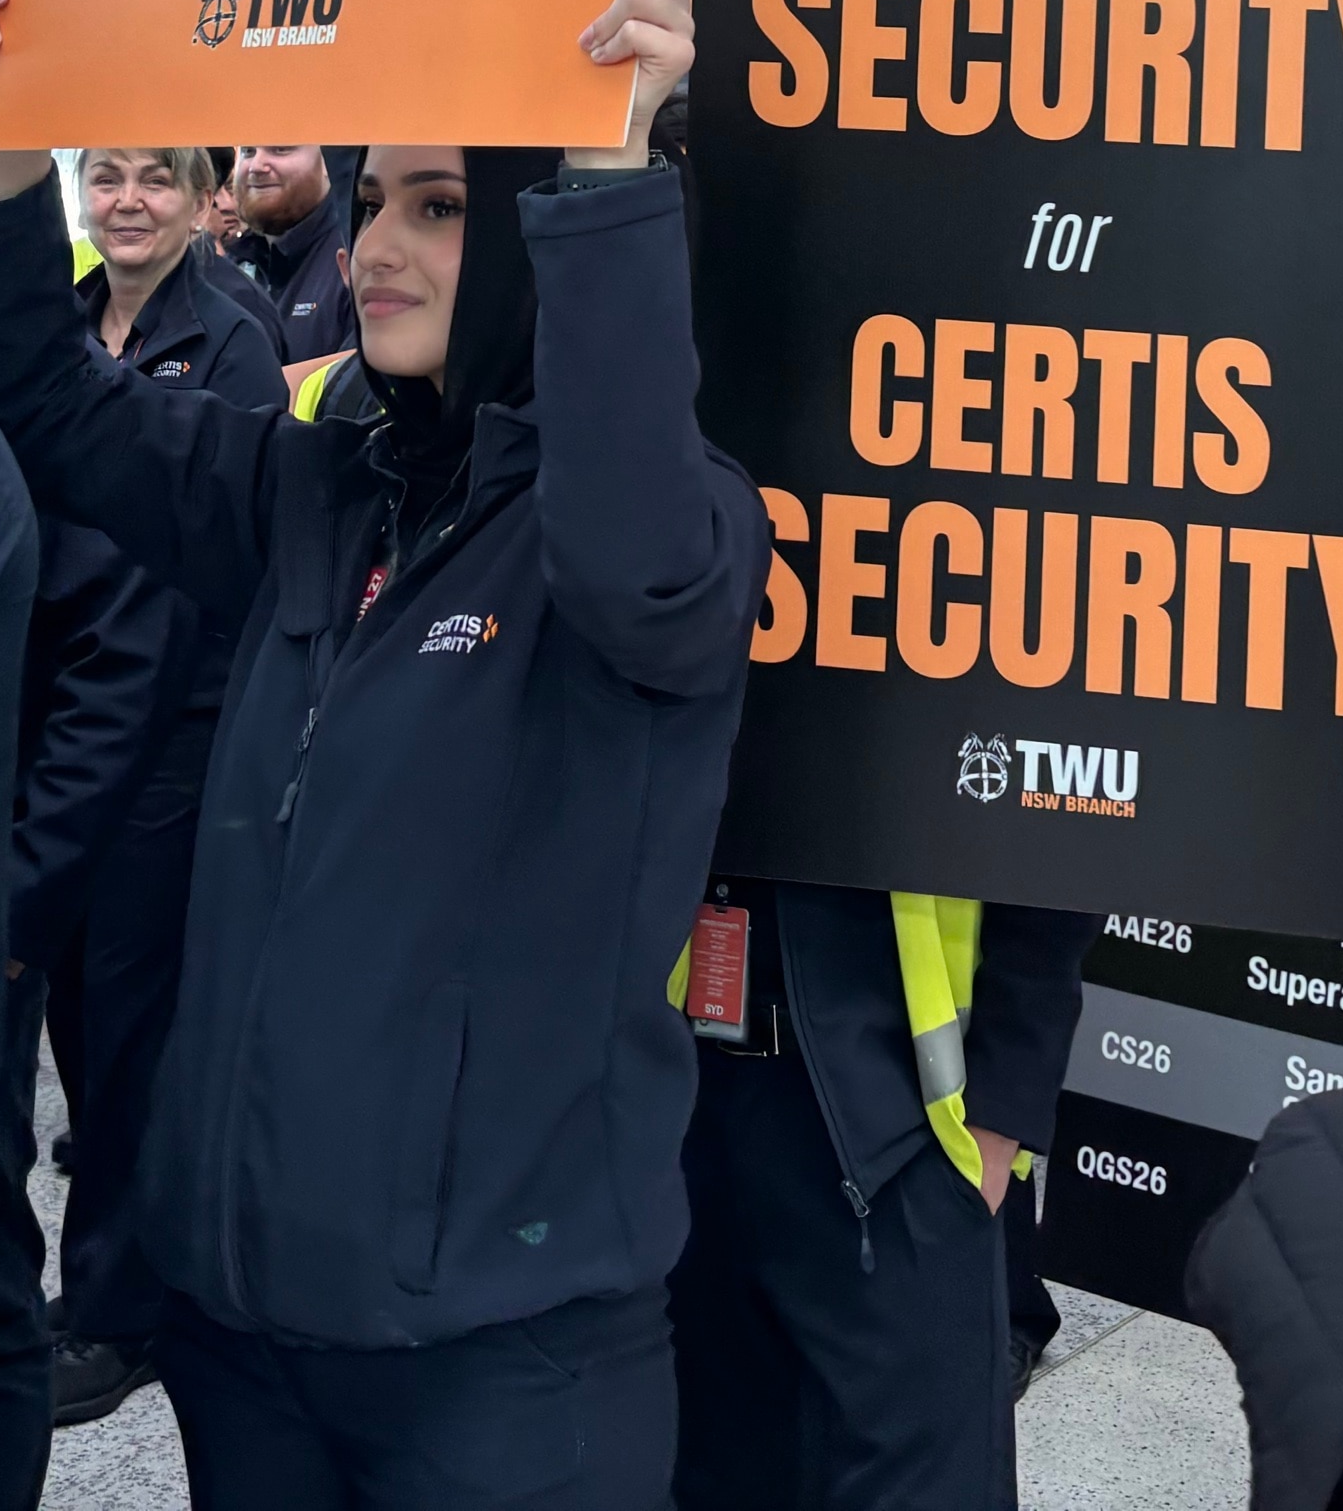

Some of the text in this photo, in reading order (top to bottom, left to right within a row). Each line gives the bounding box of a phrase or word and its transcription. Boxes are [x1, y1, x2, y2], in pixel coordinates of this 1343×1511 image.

[241, 24, 337, 48] NSW BRANCH
[1023, 202, 1113, 274] for
[851, 313, 1273, 496] CERTIS
[418, 636, 477, 654] SECURITY
[428, 614, 482, 638] CERTIS
[1016, 739, 1140, 801] TWU
[1021, 791, 1136, 818] NSW BRANCH
[1103, 914, 1193, 954] AAE26
[1101, 1031, 1172, 1074] CS26
[1076, 1146, 1168, 1195] QGS26
